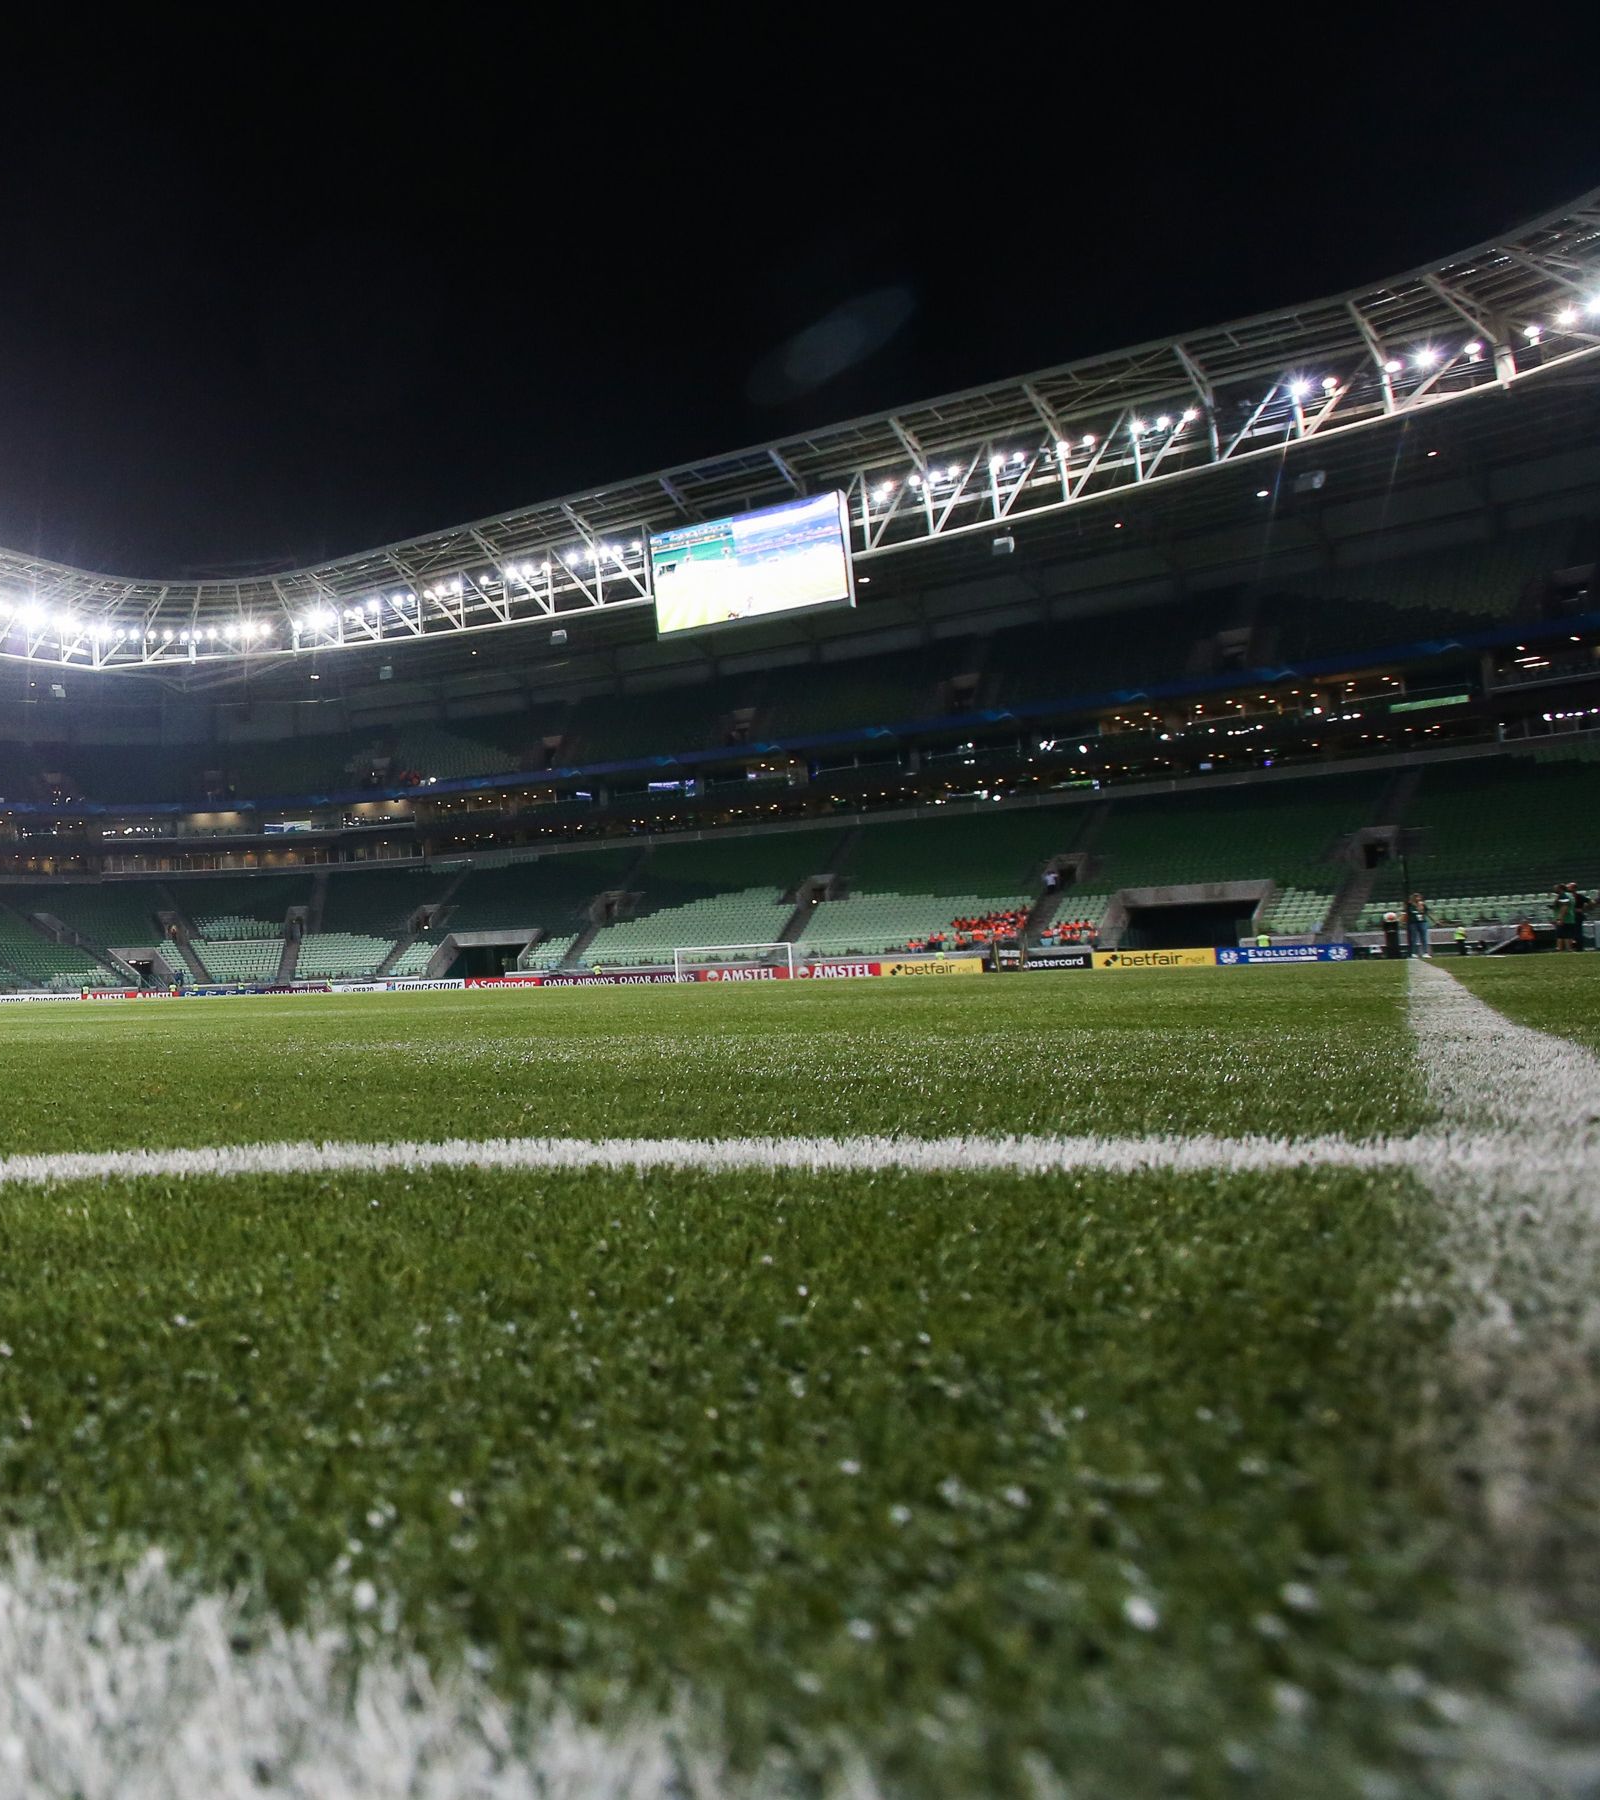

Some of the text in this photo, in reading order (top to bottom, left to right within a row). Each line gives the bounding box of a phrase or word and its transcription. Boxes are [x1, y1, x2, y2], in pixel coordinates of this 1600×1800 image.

[721, 968, 777, 981] AMSTEL
[813, 964, 873, 978] AMSTEL
[480, 979, 536, 988] Santander
[544, 977, 616, 987] QATAR AIRWAYS
[620, 976, 651, 984] QATAR
